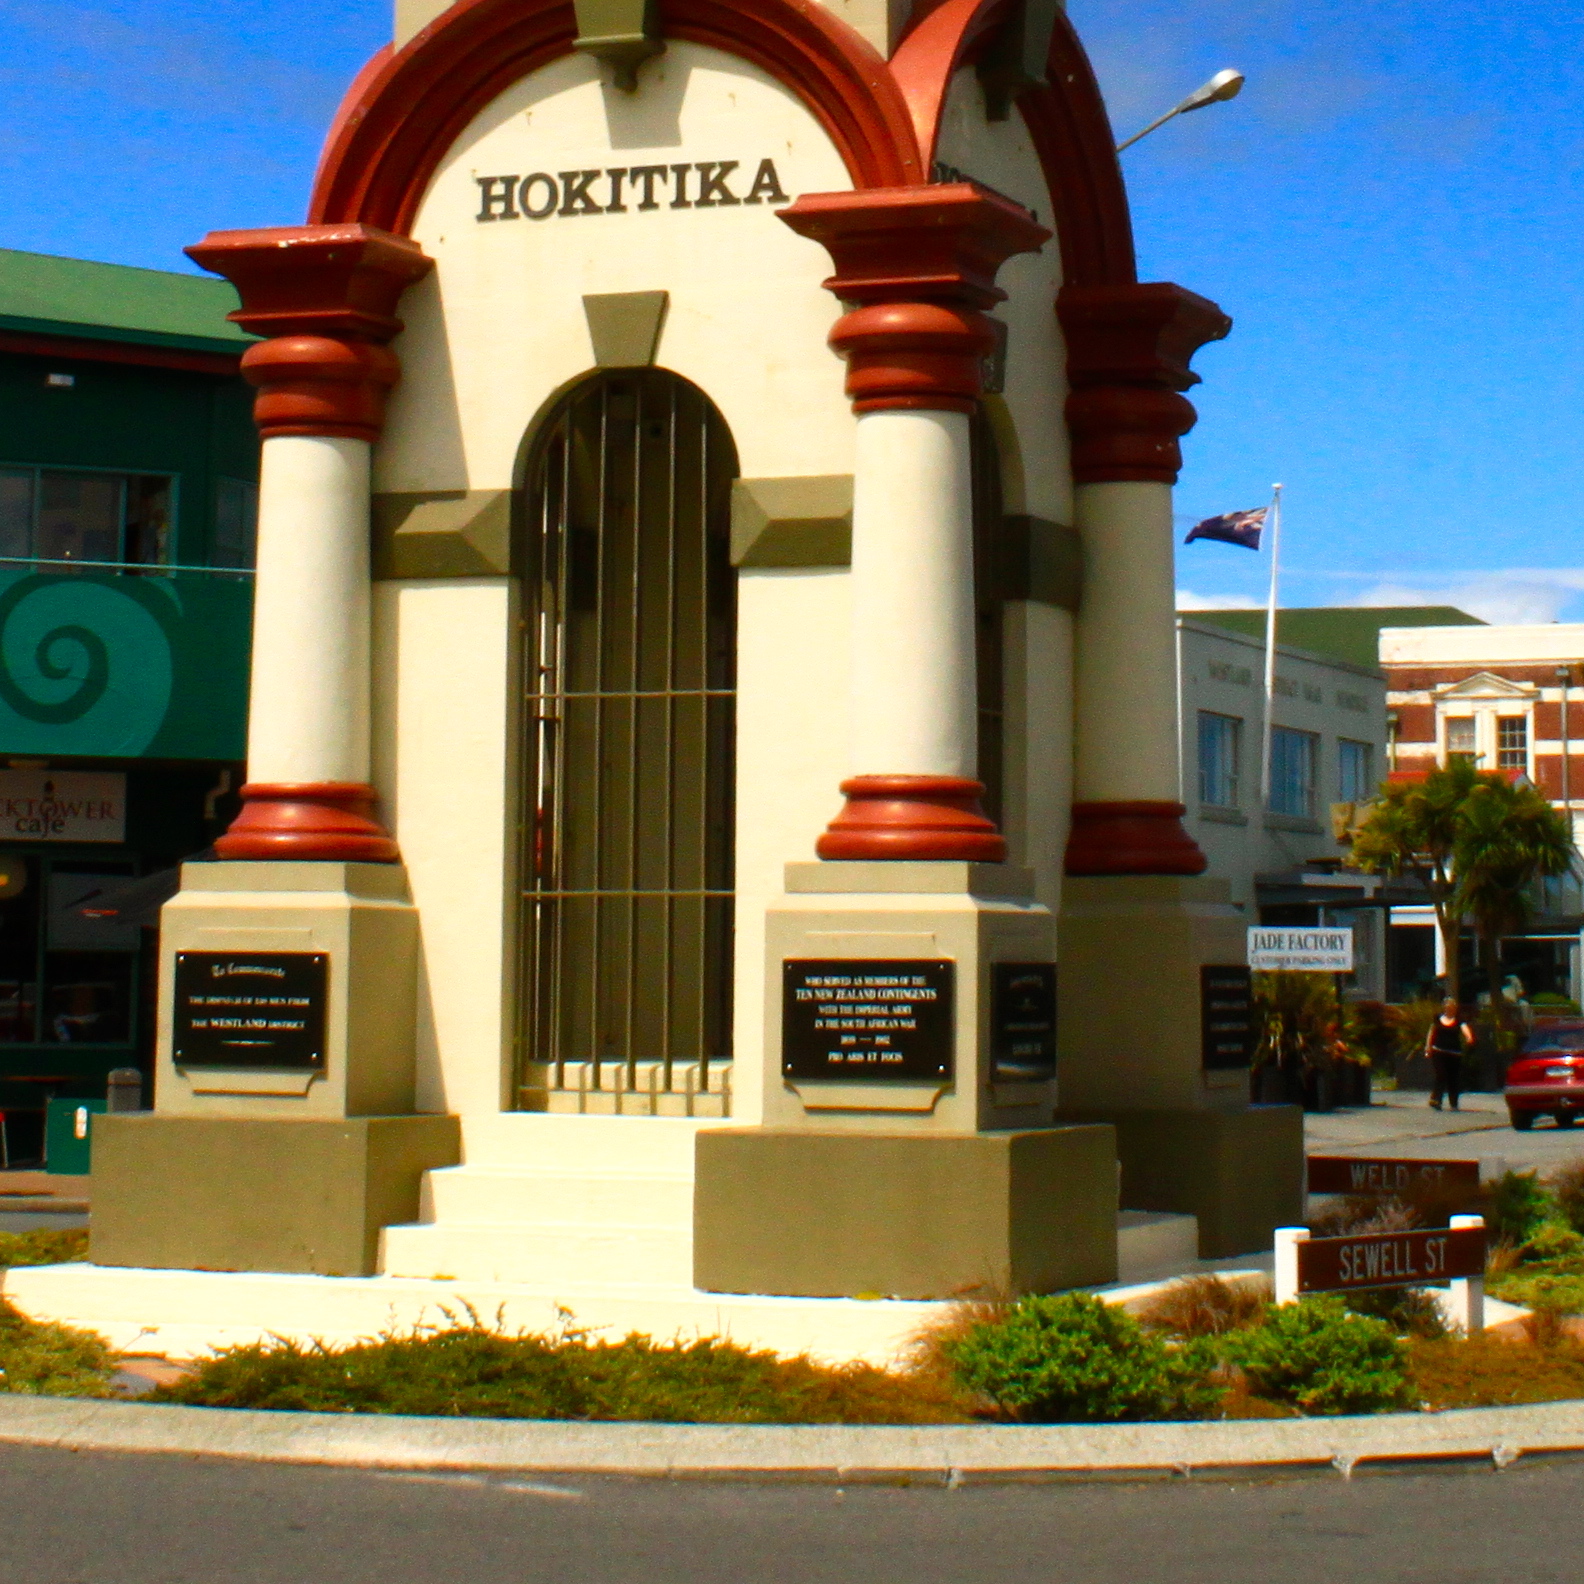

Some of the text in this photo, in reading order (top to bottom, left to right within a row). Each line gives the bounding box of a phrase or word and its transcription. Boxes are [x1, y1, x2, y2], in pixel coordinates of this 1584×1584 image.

[476, 158, 790, 223] HOKITIKA
[15, 817, 65, 840] cafe
[1251, 933, 1347, 954] JADE FACTORY
[796, 988, 938, 1001] TEN NEW ZEALAND CONTINGENTS
[209, 1018, 267, 1029] WESTLAND
[1350, 1162, 1447, 1190] WELD ST
[1338, 1236, 1449, 1283] SEWELL ST
